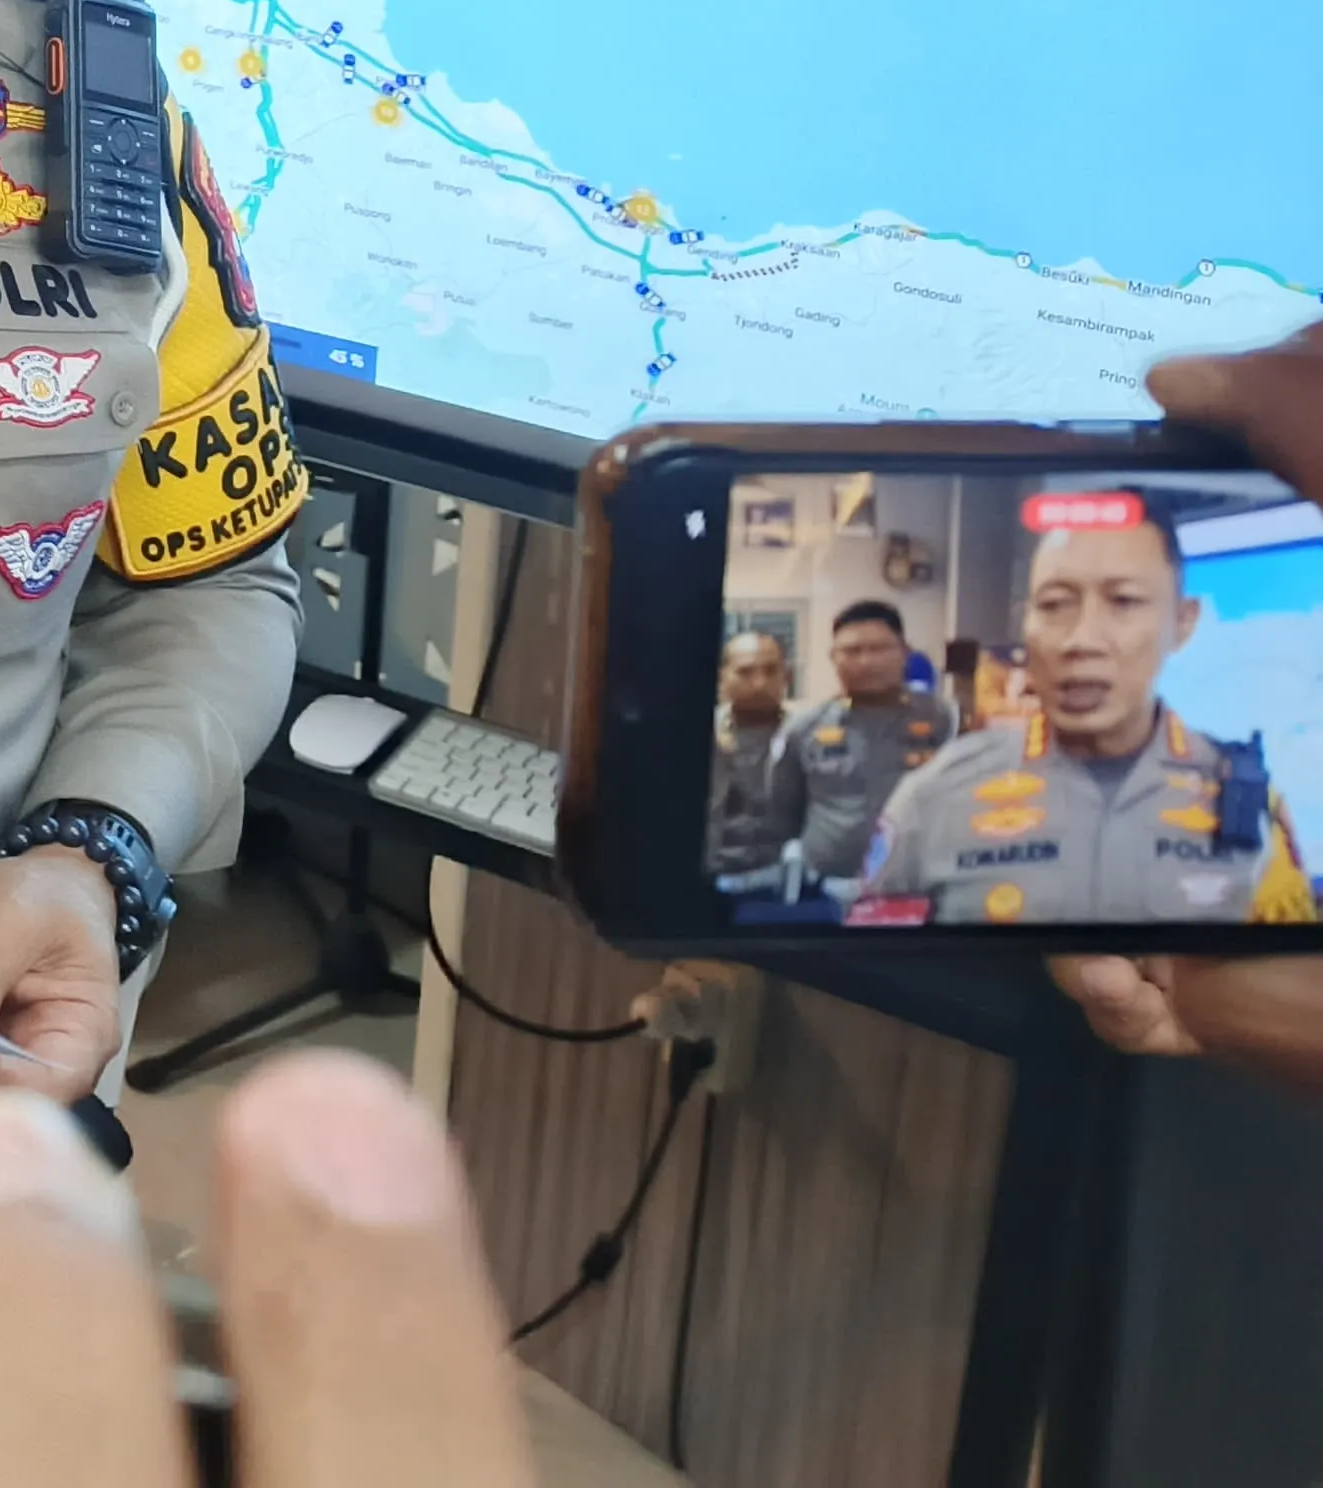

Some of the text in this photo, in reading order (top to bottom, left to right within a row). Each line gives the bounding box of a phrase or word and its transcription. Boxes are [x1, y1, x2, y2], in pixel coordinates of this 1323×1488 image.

[106, 12, 131, 28] Hytera
[780, 238, 841, 260] Kraksaan
[893, 281, 963, 304] Gondosuli
[1127, 280, 1212, 306] Mandingan
[794, 306, 841, 328] Gading
[1036, 308, 1156, 342] Kesambirampak
[140, 525, 205, 563] OPS
